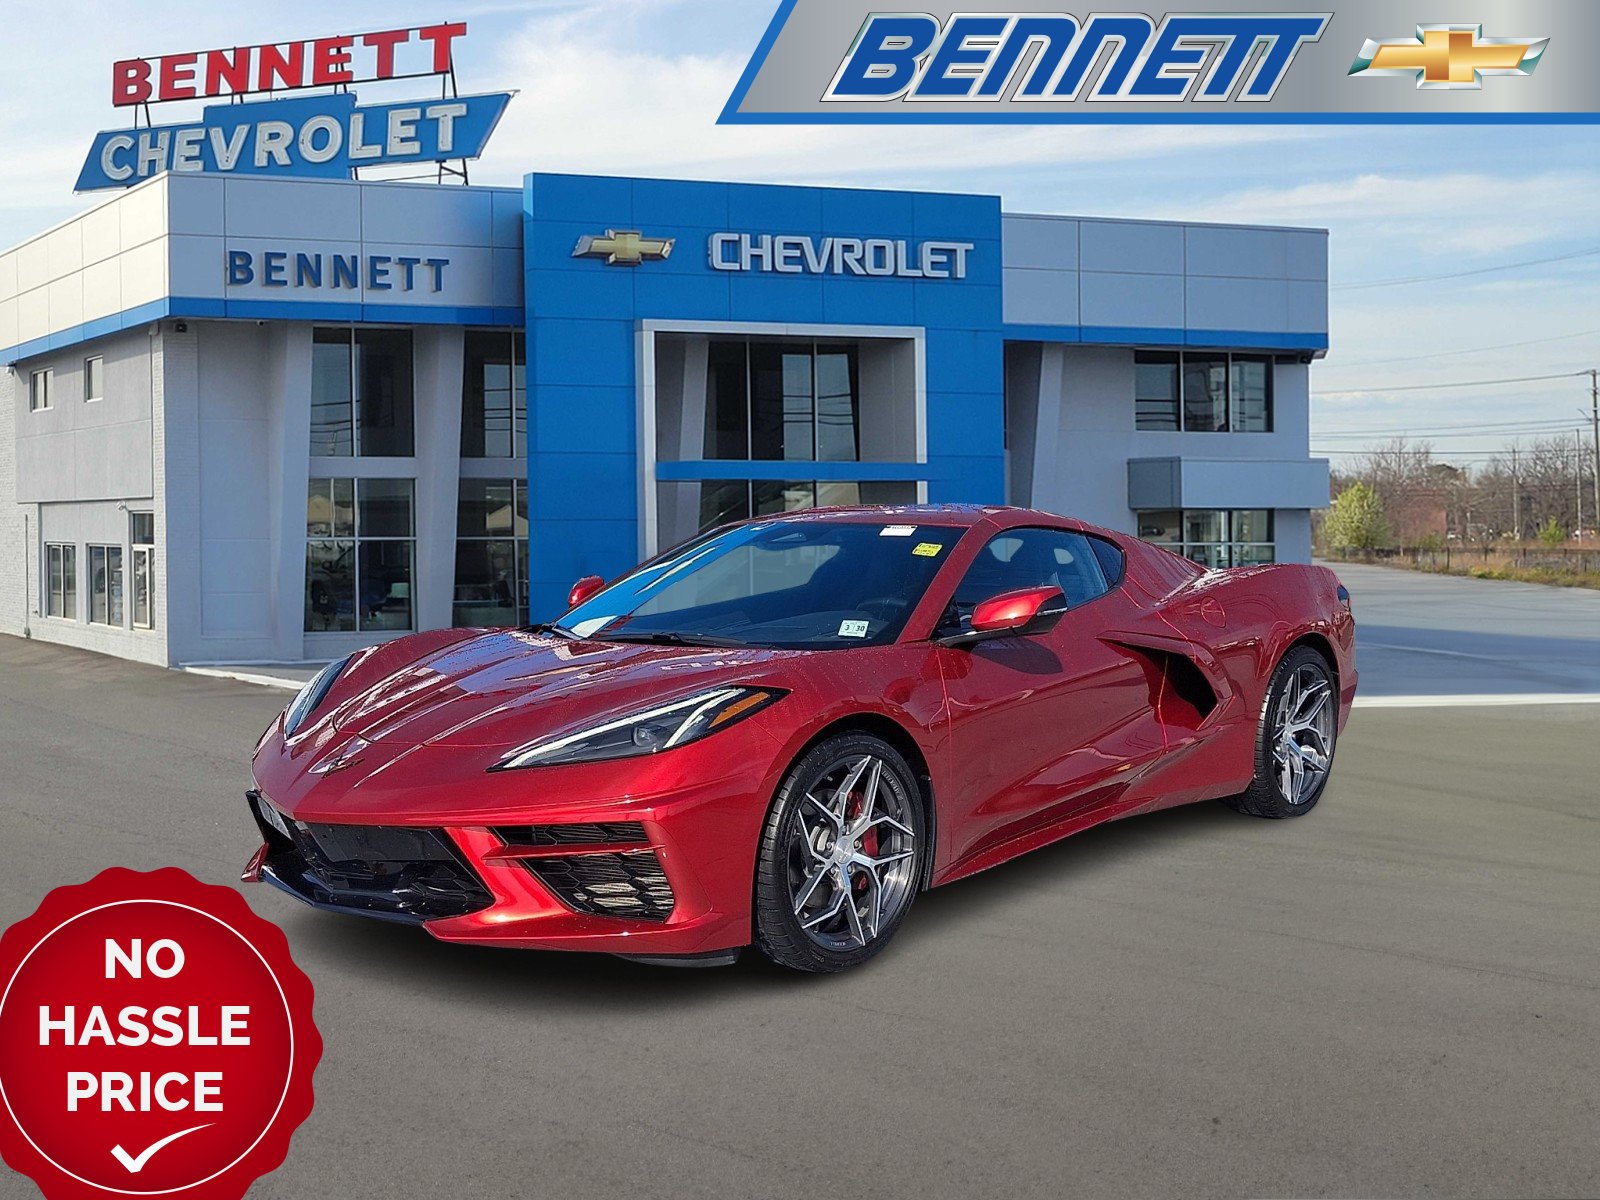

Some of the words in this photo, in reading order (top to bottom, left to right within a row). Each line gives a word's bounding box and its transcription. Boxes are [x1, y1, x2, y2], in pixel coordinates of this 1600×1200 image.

[112, 22, 467, 107] BENNETT
[100, 102, 468, 181] CHEVROLET
[226, 249, 450, 293] BENNETT
[708, 232, 975, 279] CHEVROLET
